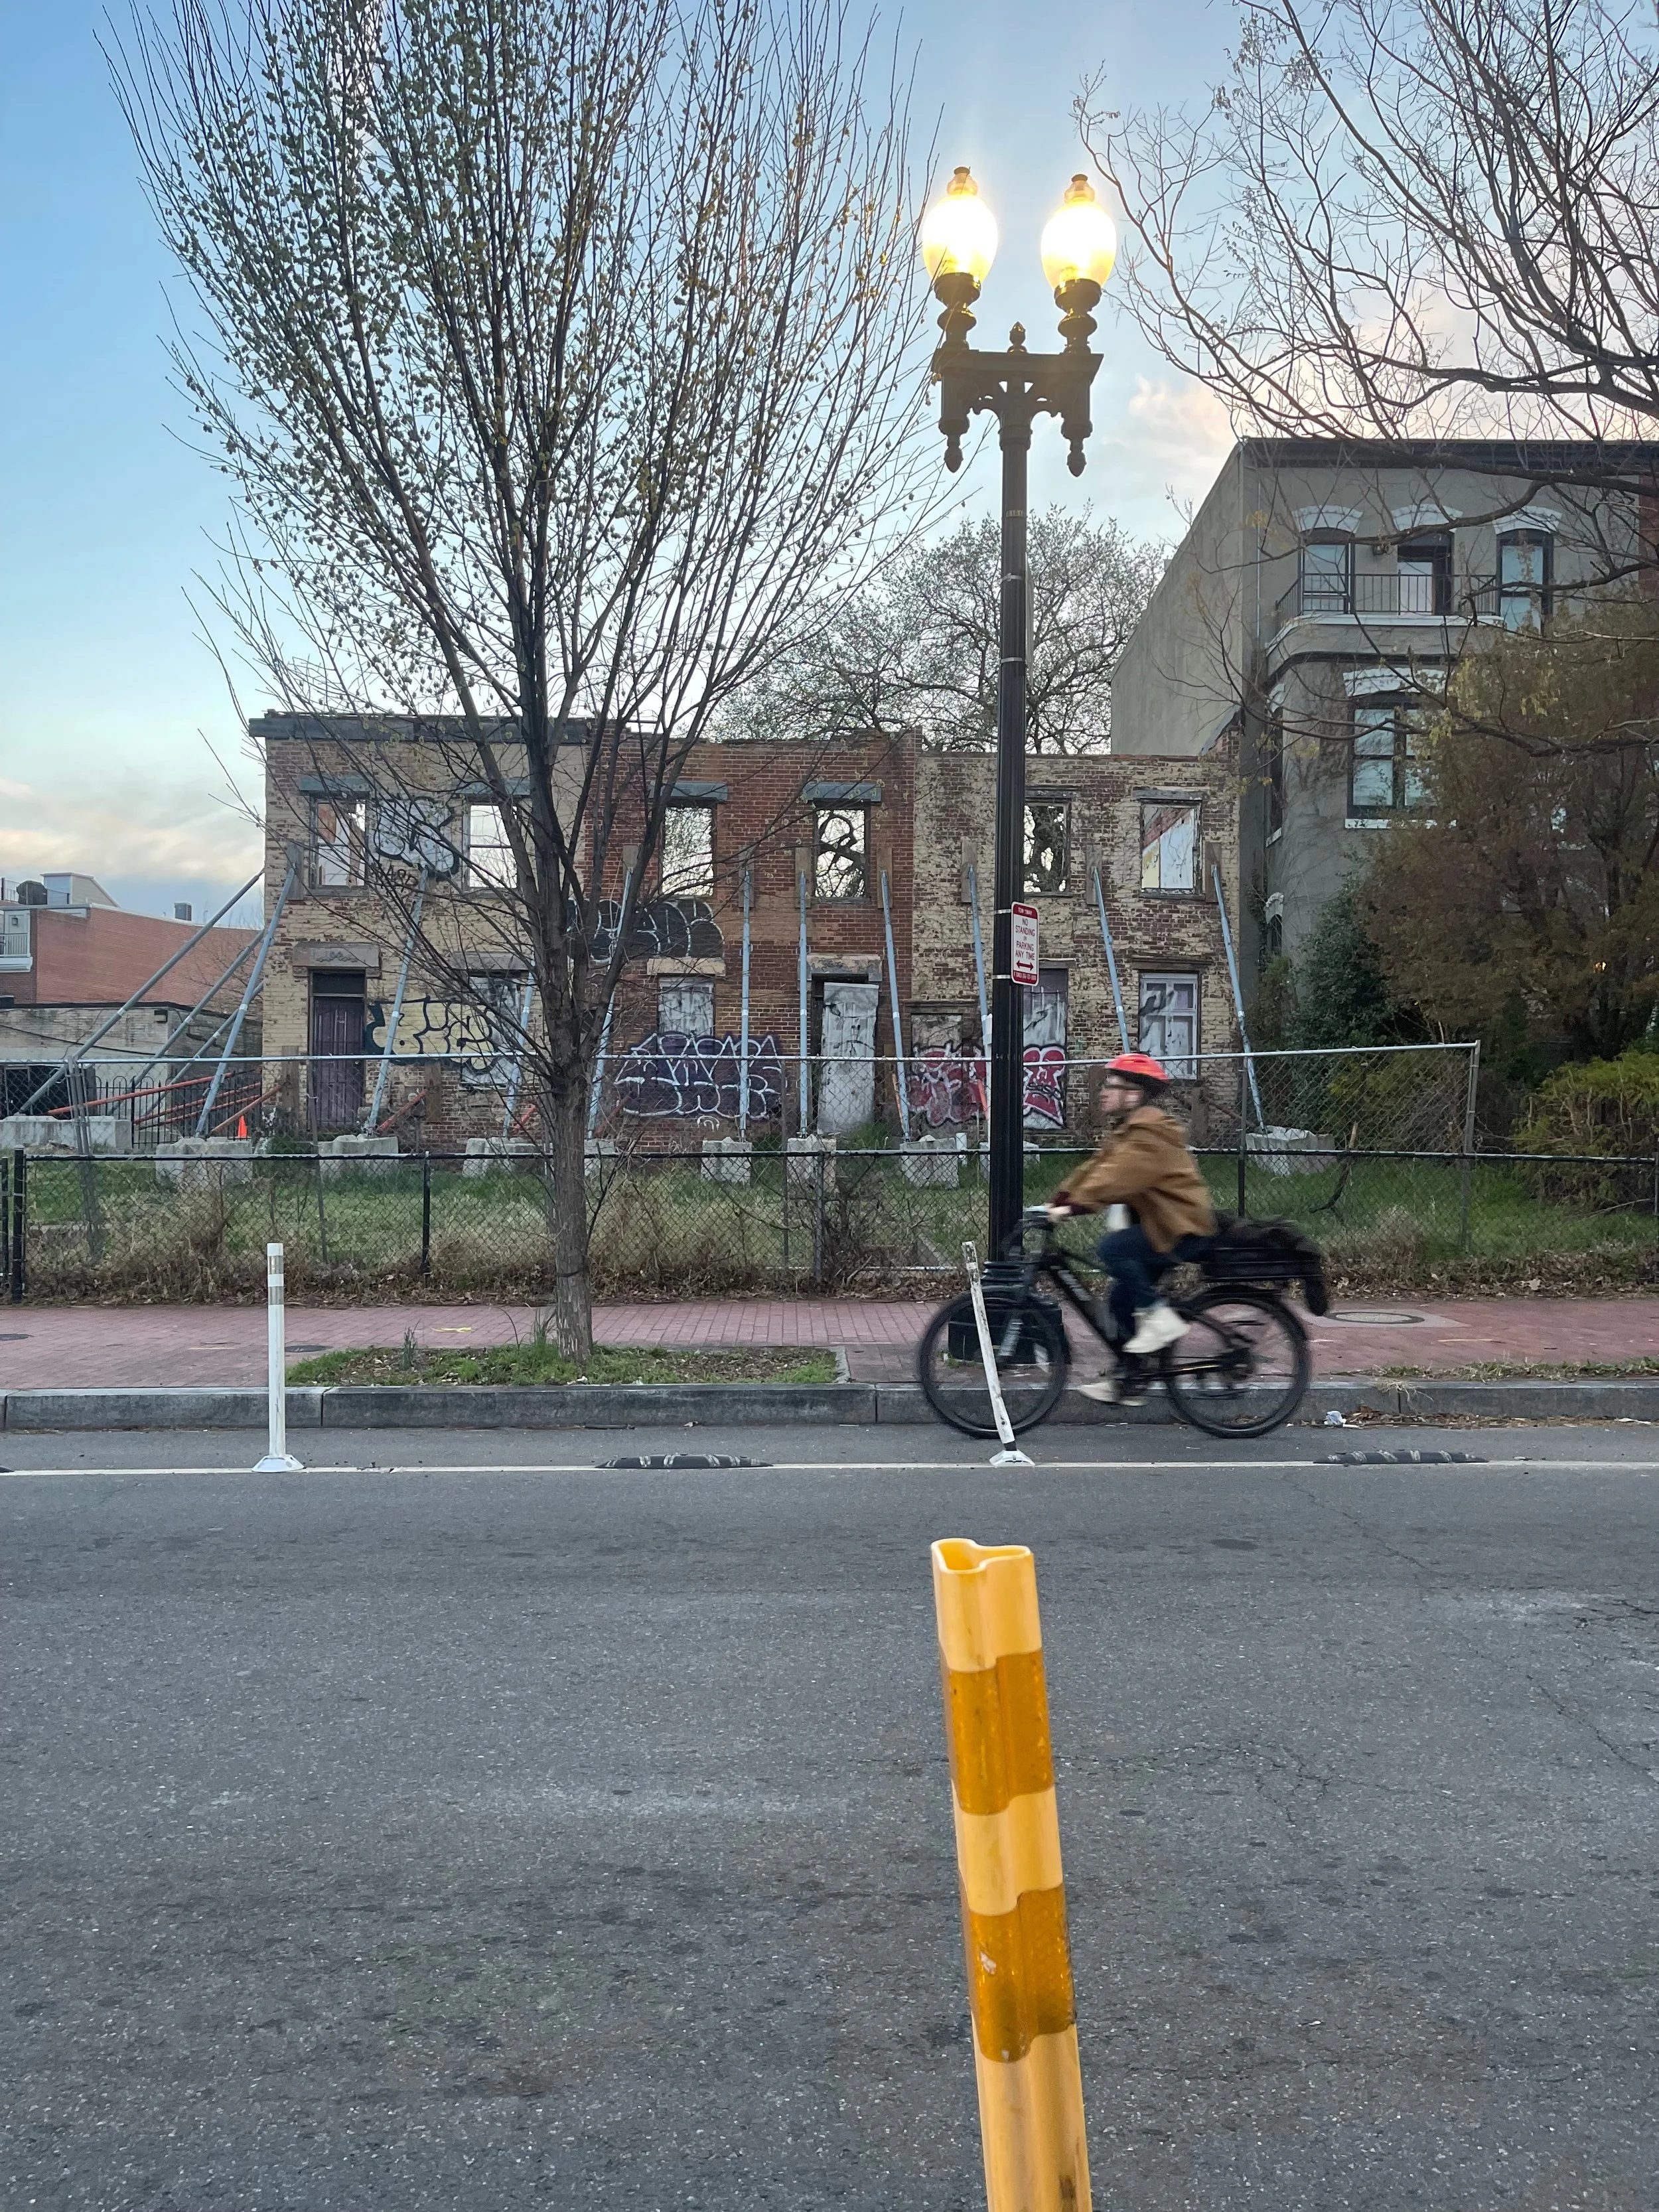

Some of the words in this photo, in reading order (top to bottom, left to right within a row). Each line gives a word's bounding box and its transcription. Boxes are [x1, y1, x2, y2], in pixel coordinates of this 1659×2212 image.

[1015, 925, 1035, 936] STANDING
[1016, 940, 1034, 952] PARKING
[1025, 951, 1035, 960] TIME
